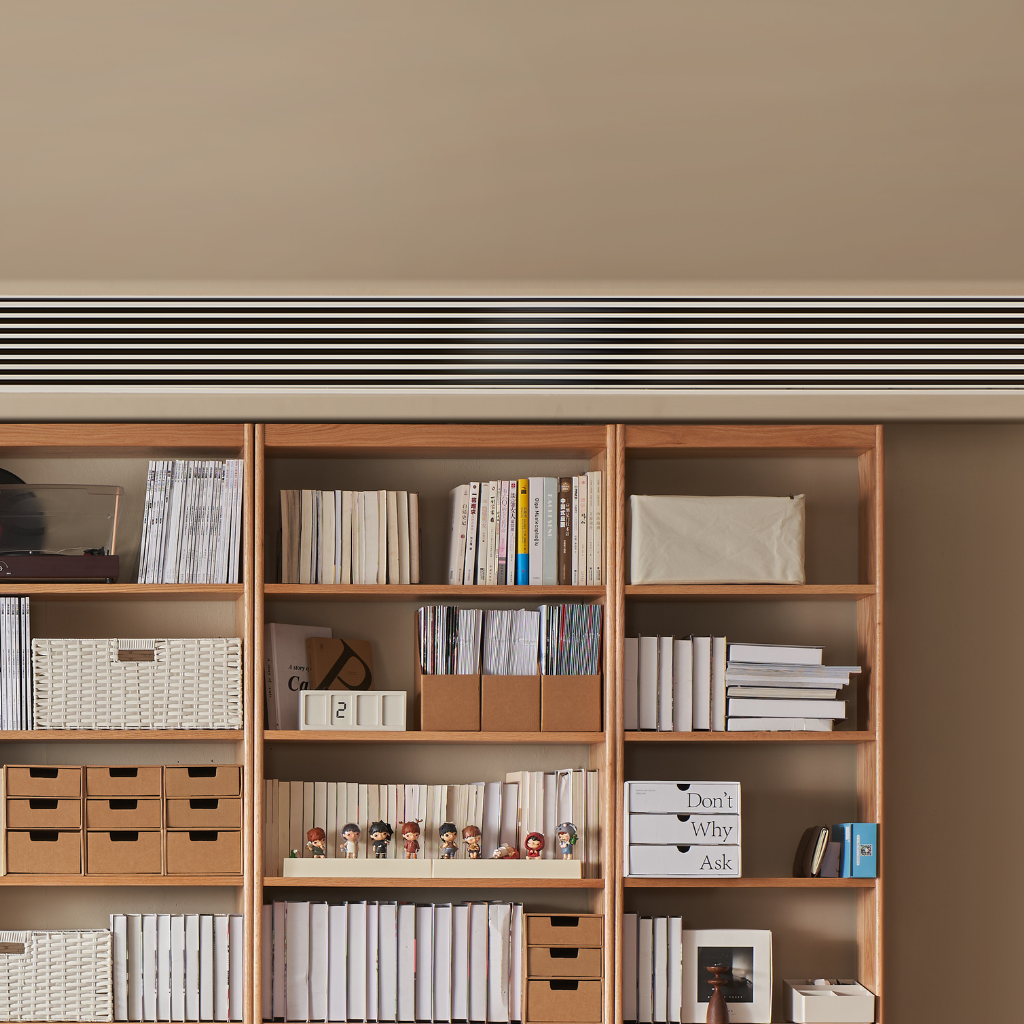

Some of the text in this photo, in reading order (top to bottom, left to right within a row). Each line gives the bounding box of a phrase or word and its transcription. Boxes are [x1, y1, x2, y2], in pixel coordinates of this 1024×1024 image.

[288, 676, 309, 691] Ca
[336, 702, 346, 718] 2
[687, 792, 733, 808] Don't
[691, 821, 733, 842] Why
[700, 854, 732, 870] Ask
